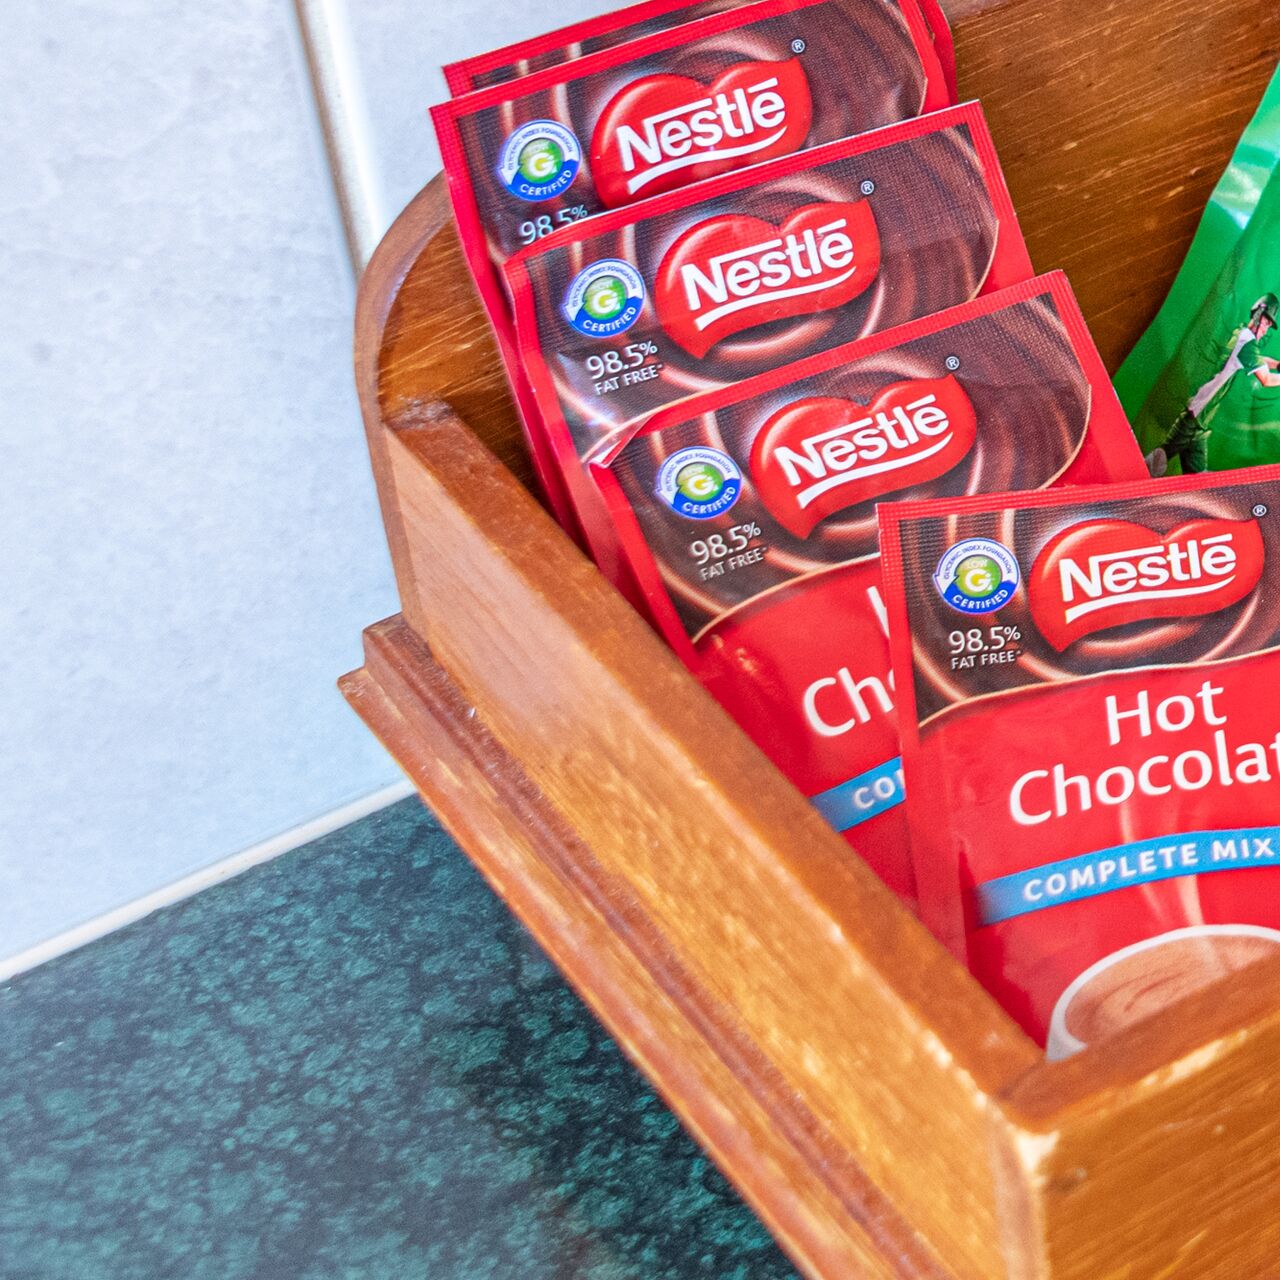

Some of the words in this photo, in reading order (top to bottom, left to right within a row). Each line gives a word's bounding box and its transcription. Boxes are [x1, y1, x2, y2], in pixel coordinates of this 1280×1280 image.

[520, 169, 572, 196] CERTIFIED
[582, 306, 637, 333] CERTIFIED
[586, 340, 658, 380] 98.5%
[594, 376, 620, 396] FAT
[682, 486, 736, 514] CERTIFIED
[690, 522, 762, 566] 98.5%
[700, 561, 726, 581] FAT
[952, 589, 1009, 610] CERTIFIED
[949, 625, 1022, 654] 98.5%
[951, 655, 976, 670] FAT
[1105, 680, 1228, 746] Hot
[1023, 840, 1199, 904] COMPLETE
[1211, 837, 1275, 863] MIX
